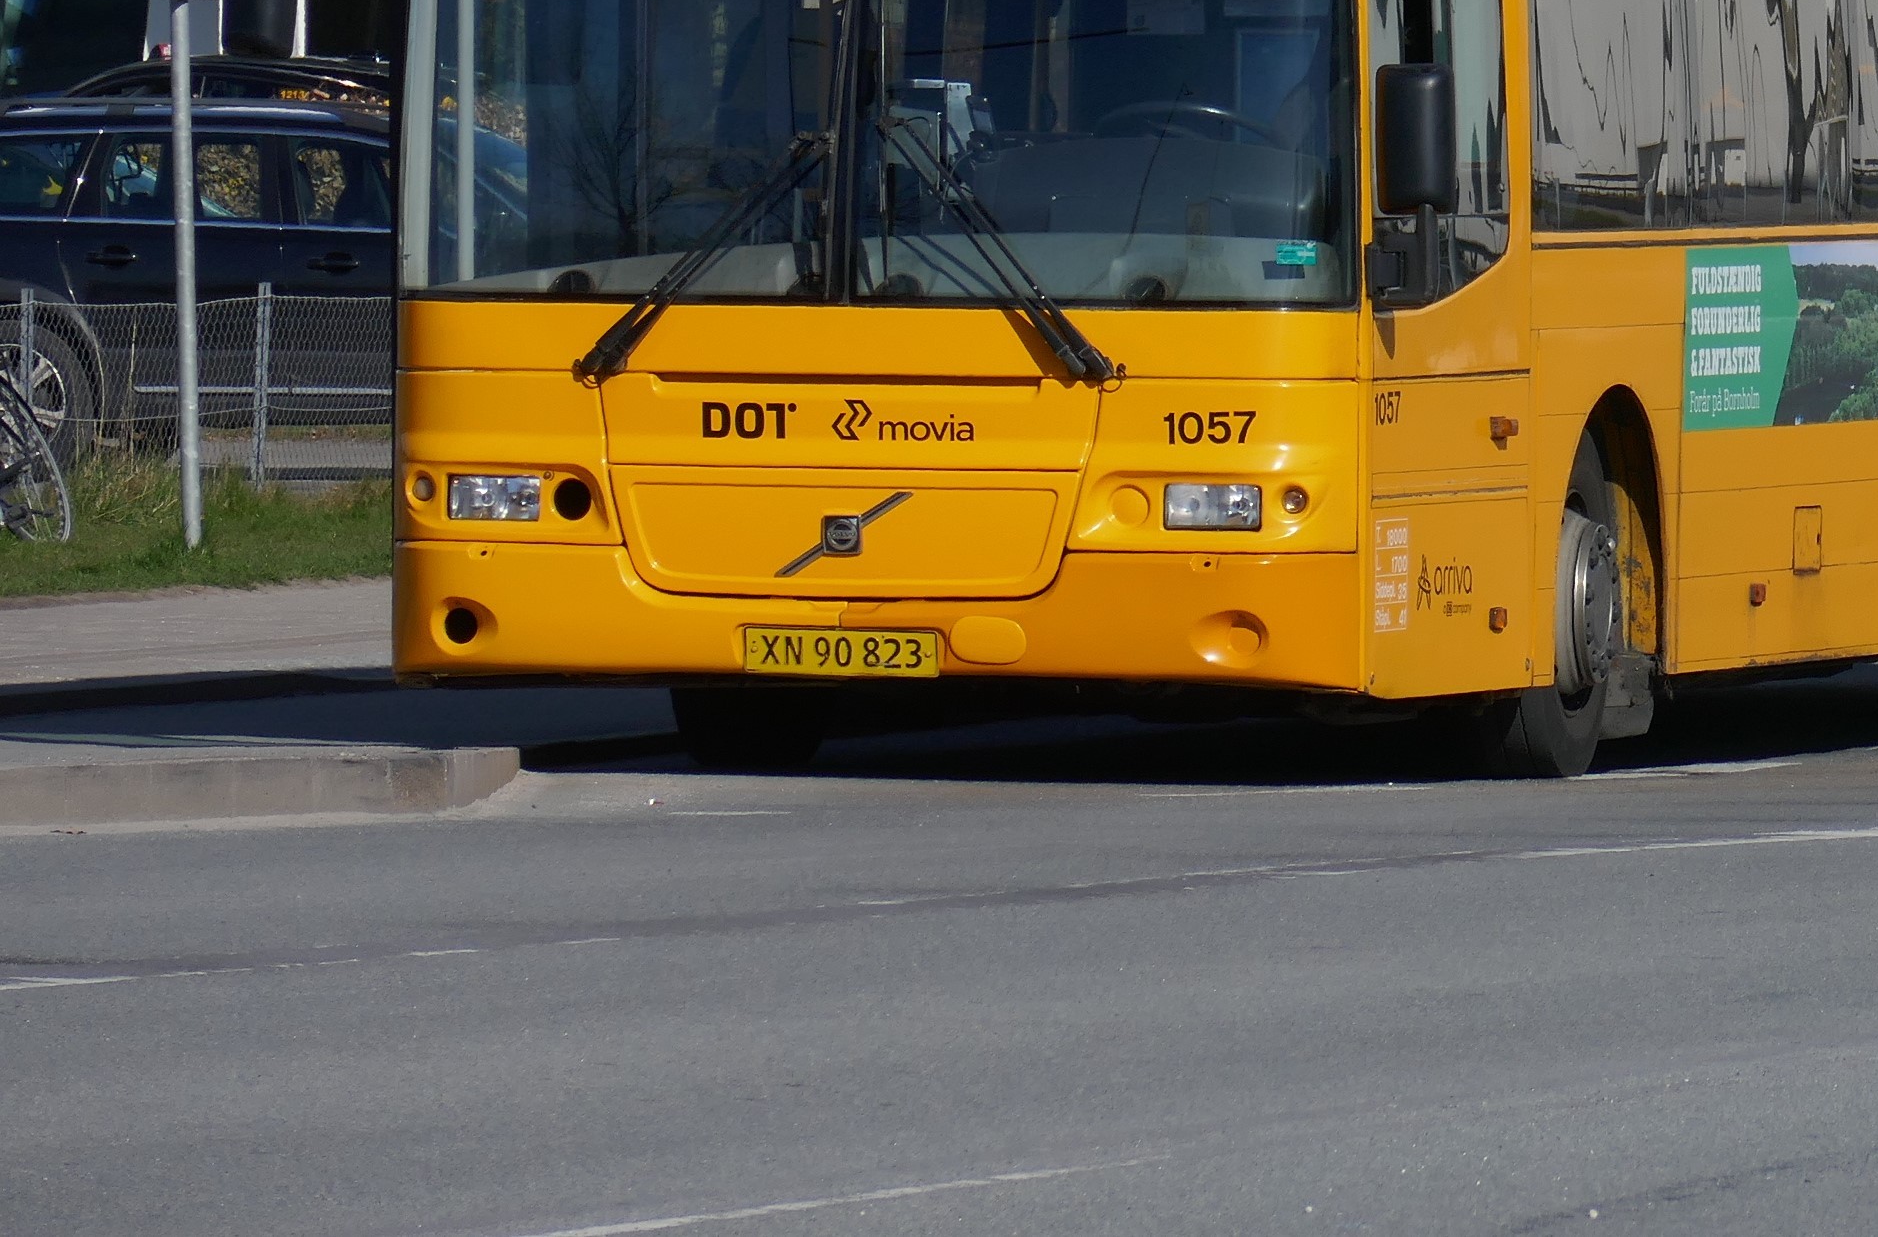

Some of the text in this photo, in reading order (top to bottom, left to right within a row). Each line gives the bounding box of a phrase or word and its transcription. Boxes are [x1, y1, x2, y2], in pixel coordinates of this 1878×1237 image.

[1691, 264, 1762, 295] FULDSTÆNDIG
[1690, 305, 1761, 335] FORUNDERLIG
[1690, 346, 1761, 377] & FANTASTISK
[1374, 391, 1401, 426] 1057
[1689, 387, 1761, 417] Forår på Bornholm
[702, 400, 975, 442] DOT movia
[1163, 410, 1257, 445] 1057
[1434, 556, 1473, 595] arriva
[761, 635, 923, 669] XN 90 823
